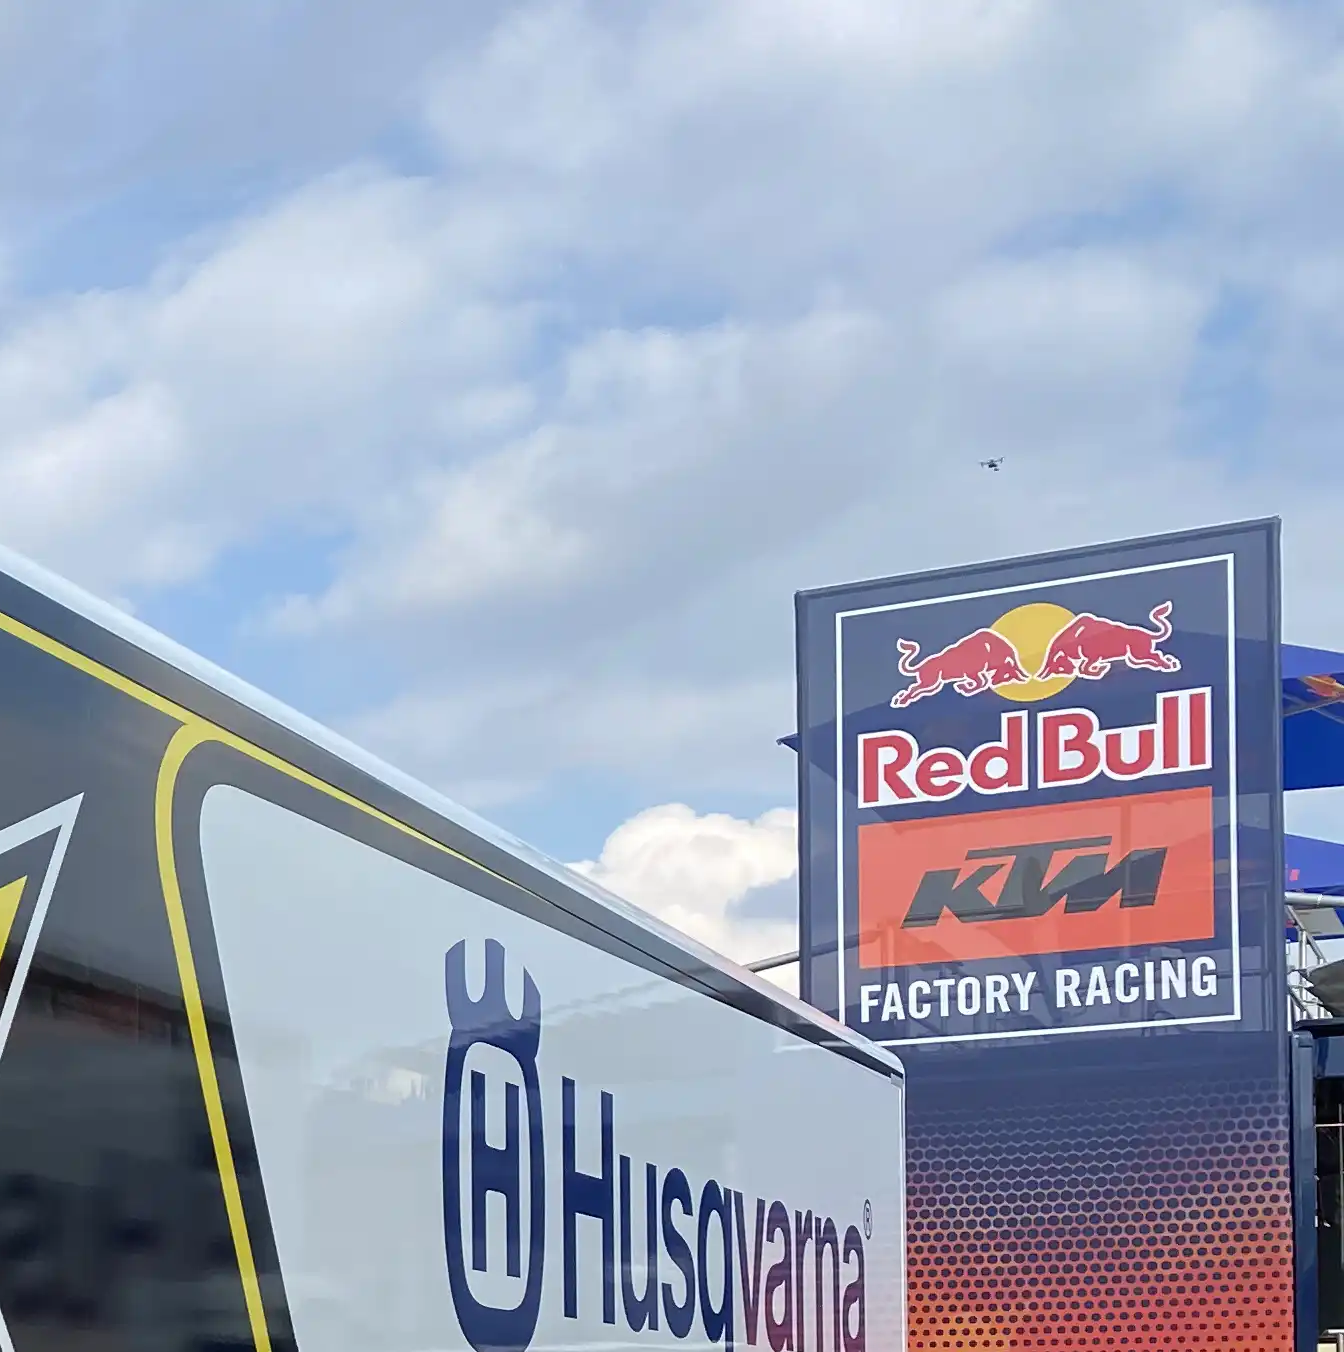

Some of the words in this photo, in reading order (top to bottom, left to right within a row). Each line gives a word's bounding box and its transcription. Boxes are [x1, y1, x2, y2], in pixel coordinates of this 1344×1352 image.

[857, 709, 1029, 809] Red
[1036, 686, 1213, 790] Bull
[899, 835, 1168, 930] KTM
[859, 970, 1037, 1025] FACTORY
[1056, 956, 1218, 1010] RACING
